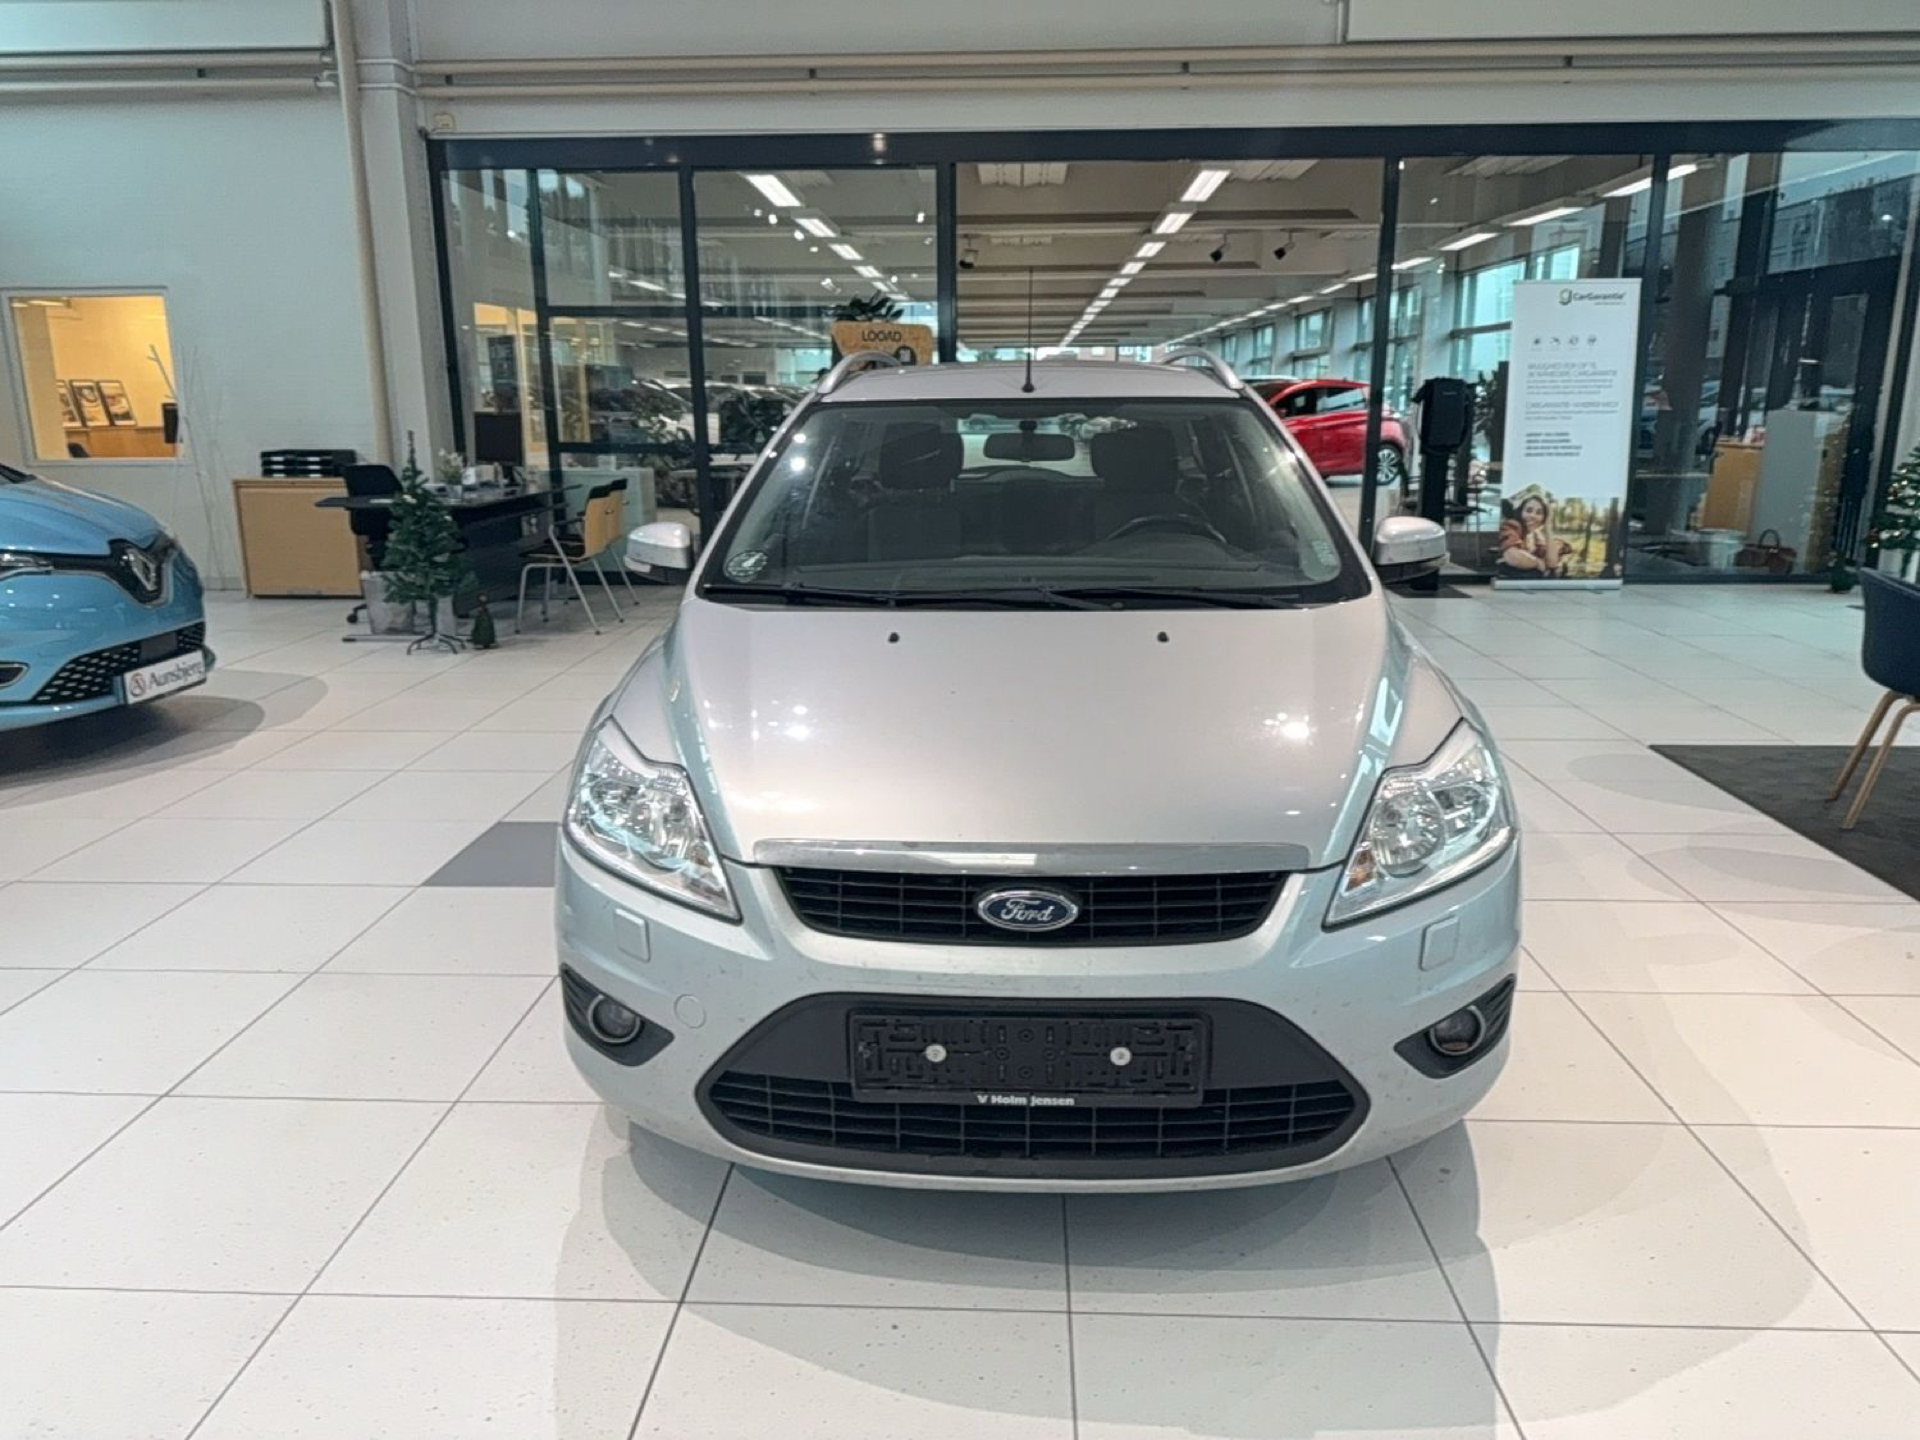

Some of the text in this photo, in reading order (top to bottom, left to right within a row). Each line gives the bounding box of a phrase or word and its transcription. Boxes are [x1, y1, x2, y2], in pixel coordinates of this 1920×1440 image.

[1001, 899, 1055, 921] Ford
[977, 1094, 988, 1104] V
[991, 1094, 1028, 1106] Holm
